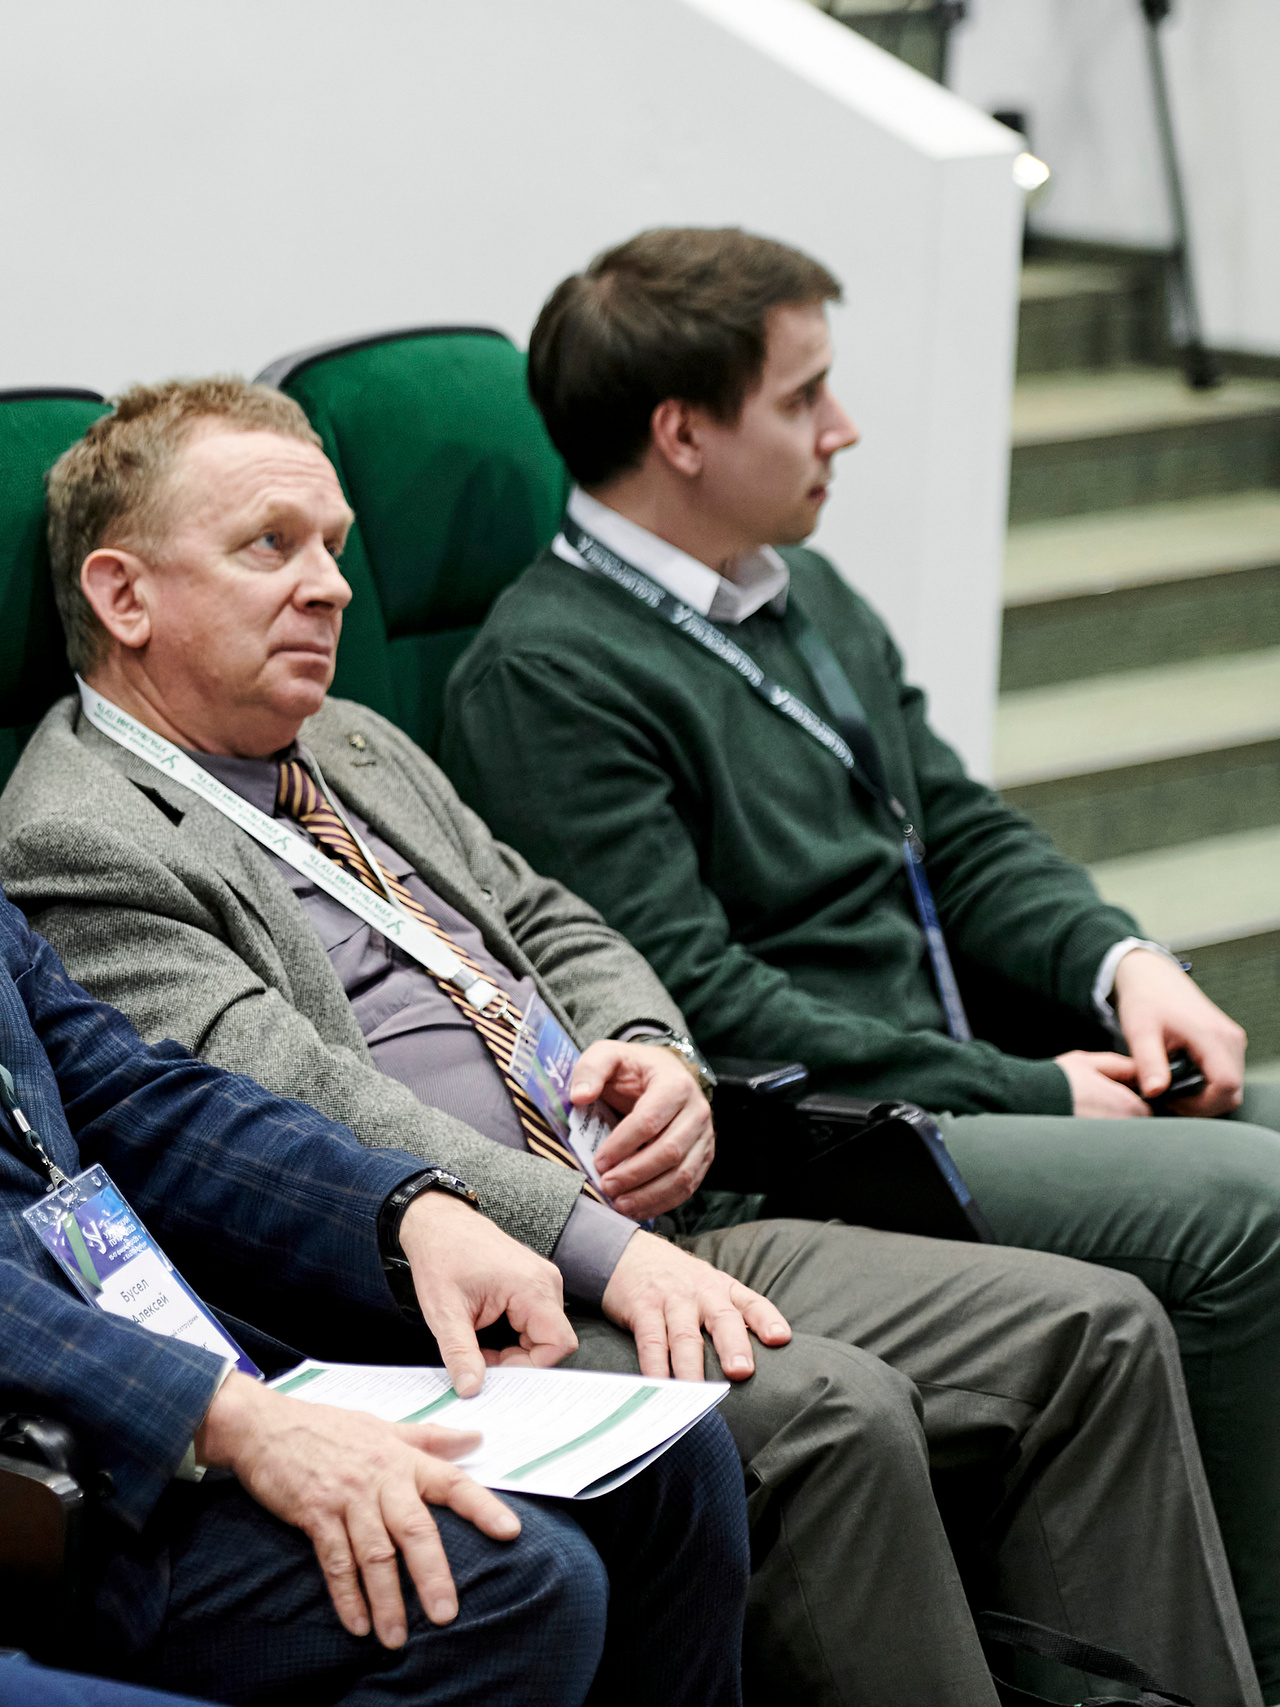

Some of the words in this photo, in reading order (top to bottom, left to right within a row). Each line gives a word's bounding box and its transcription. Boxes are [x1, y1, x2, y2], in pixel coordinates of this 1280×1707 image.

[119, 1276, 150, 1306] Бусел
[129, 1289, 170, 1327] Алексей
[176, 1313, 199, 1334] сотрудник
